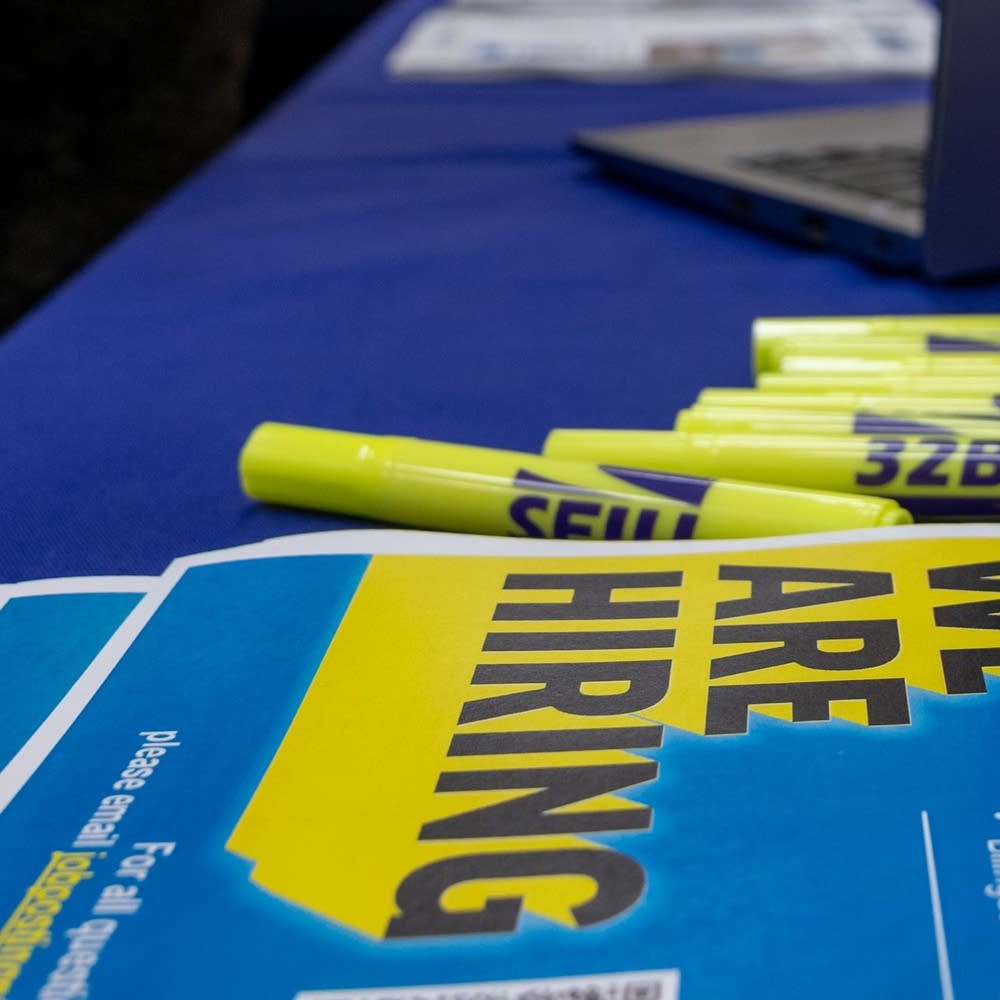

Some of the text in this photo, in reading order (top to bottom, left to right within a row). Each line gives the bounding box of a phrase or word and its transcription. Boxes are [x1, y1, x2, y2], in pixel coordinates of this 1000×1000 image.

[704, 563, 912, 736] ARE
[113, 730, 181, 791] please
[383, 570, 683, 939] HIRING
[72, 794, 135, 848] email
[115, 842, 177, 881] For
[92, 884, 143, 915] all
